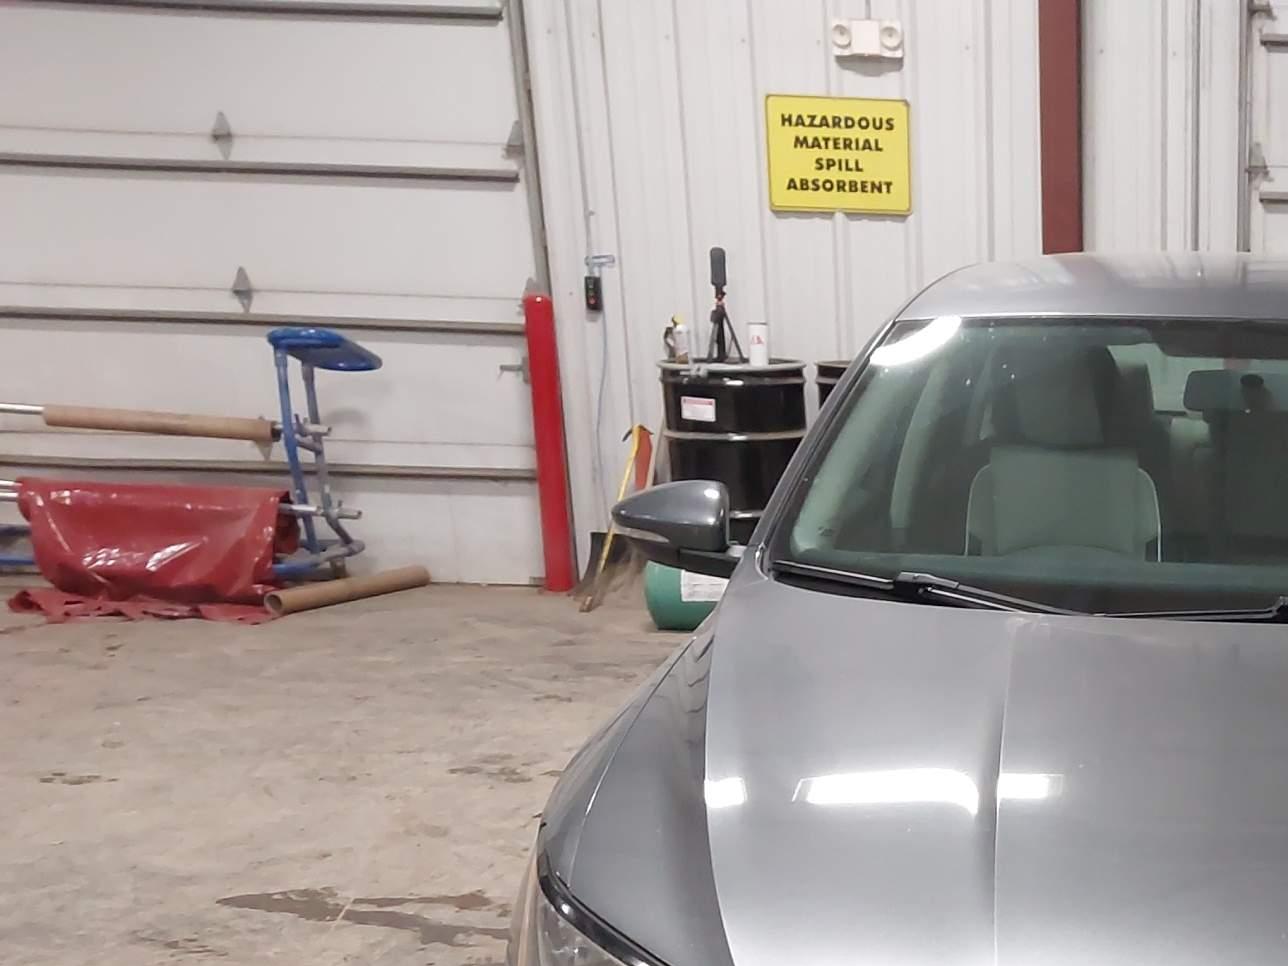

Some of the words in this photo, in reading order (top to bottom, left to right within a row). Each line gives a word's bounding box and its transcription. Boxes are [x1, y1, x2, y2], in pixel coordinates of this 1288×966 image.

[780, 113, 895, 131] HAZARDOUS
[793, 135, 884, 152] MATERIAL
[814, 157, 864, 172] SPILL
[786, 177, 893, 194] ABSORBENT
